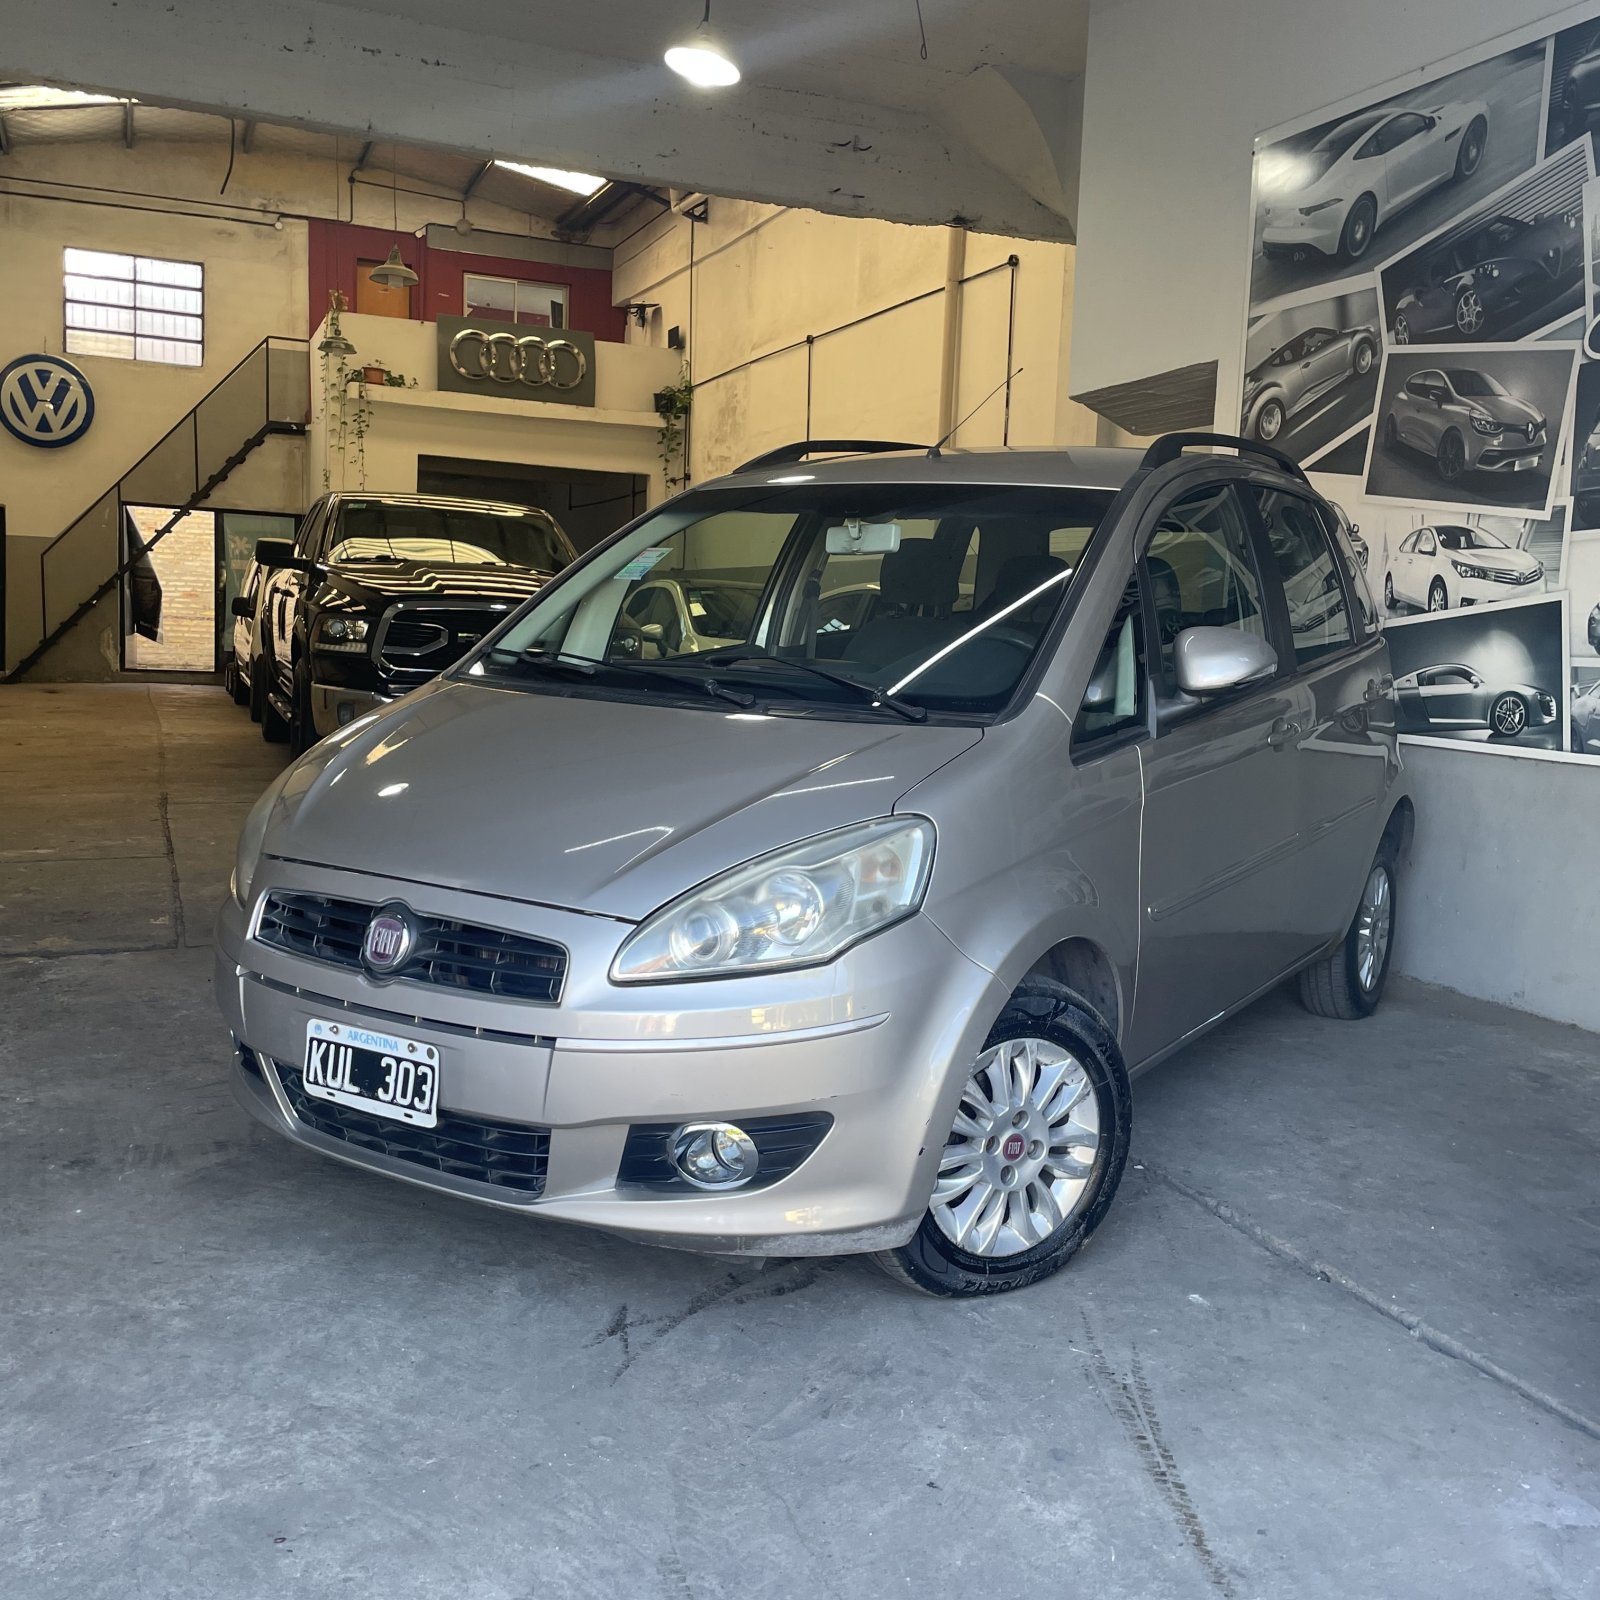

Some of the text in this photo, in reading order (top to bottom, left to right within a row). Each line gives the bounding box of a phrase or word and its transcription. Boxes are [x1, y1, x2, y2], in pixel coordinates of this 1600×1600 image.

[372, 926, 400, 955] FIAT
[347, 1029, 399, 1052] ARGENTINA
[308, 1039, 433, 1111] KUL 303
[1007, 1141, 1022, 1155] FIAT
